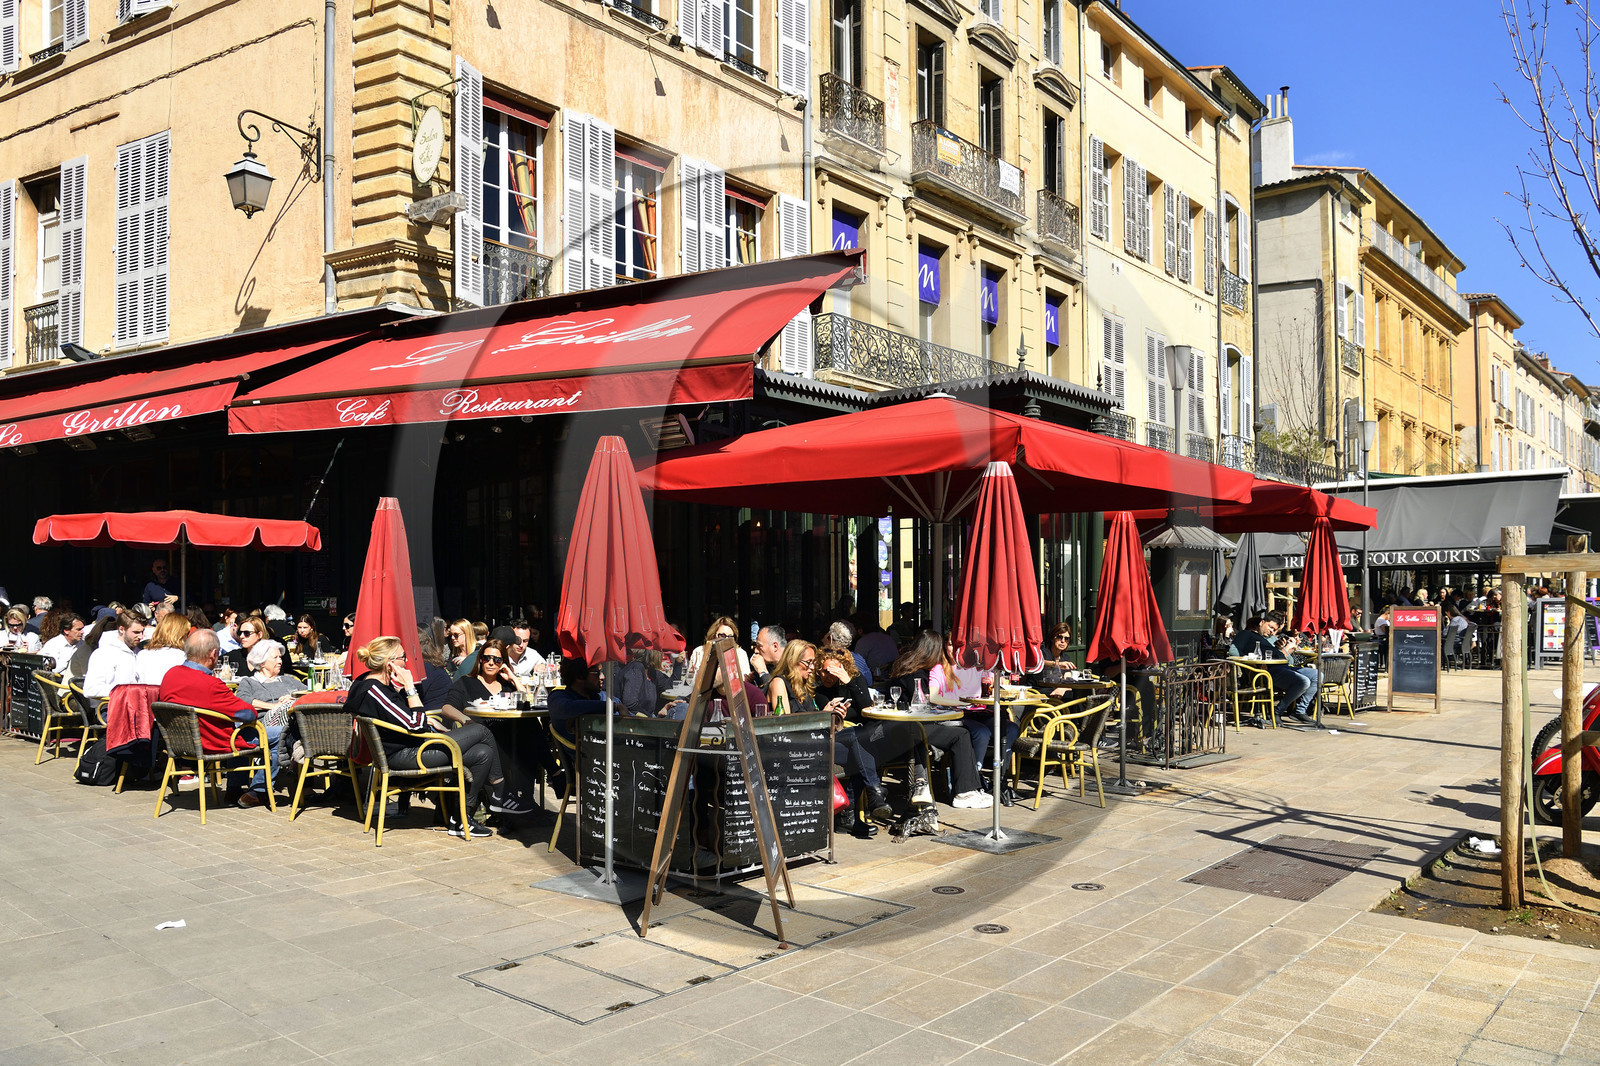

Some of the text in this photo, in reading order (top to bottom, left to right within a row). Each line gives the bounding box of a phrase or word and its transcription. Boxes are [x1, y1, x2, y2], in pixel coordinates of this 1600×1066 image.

[490, 314, 695, 356] Grillon
[62, 400, 183, 437] Grillon
[336, 388, 583, 426] Café Restaurant
[1366, 551, 1408, 566] FOUR
[1412, 548, 1481, 564] COURTS
